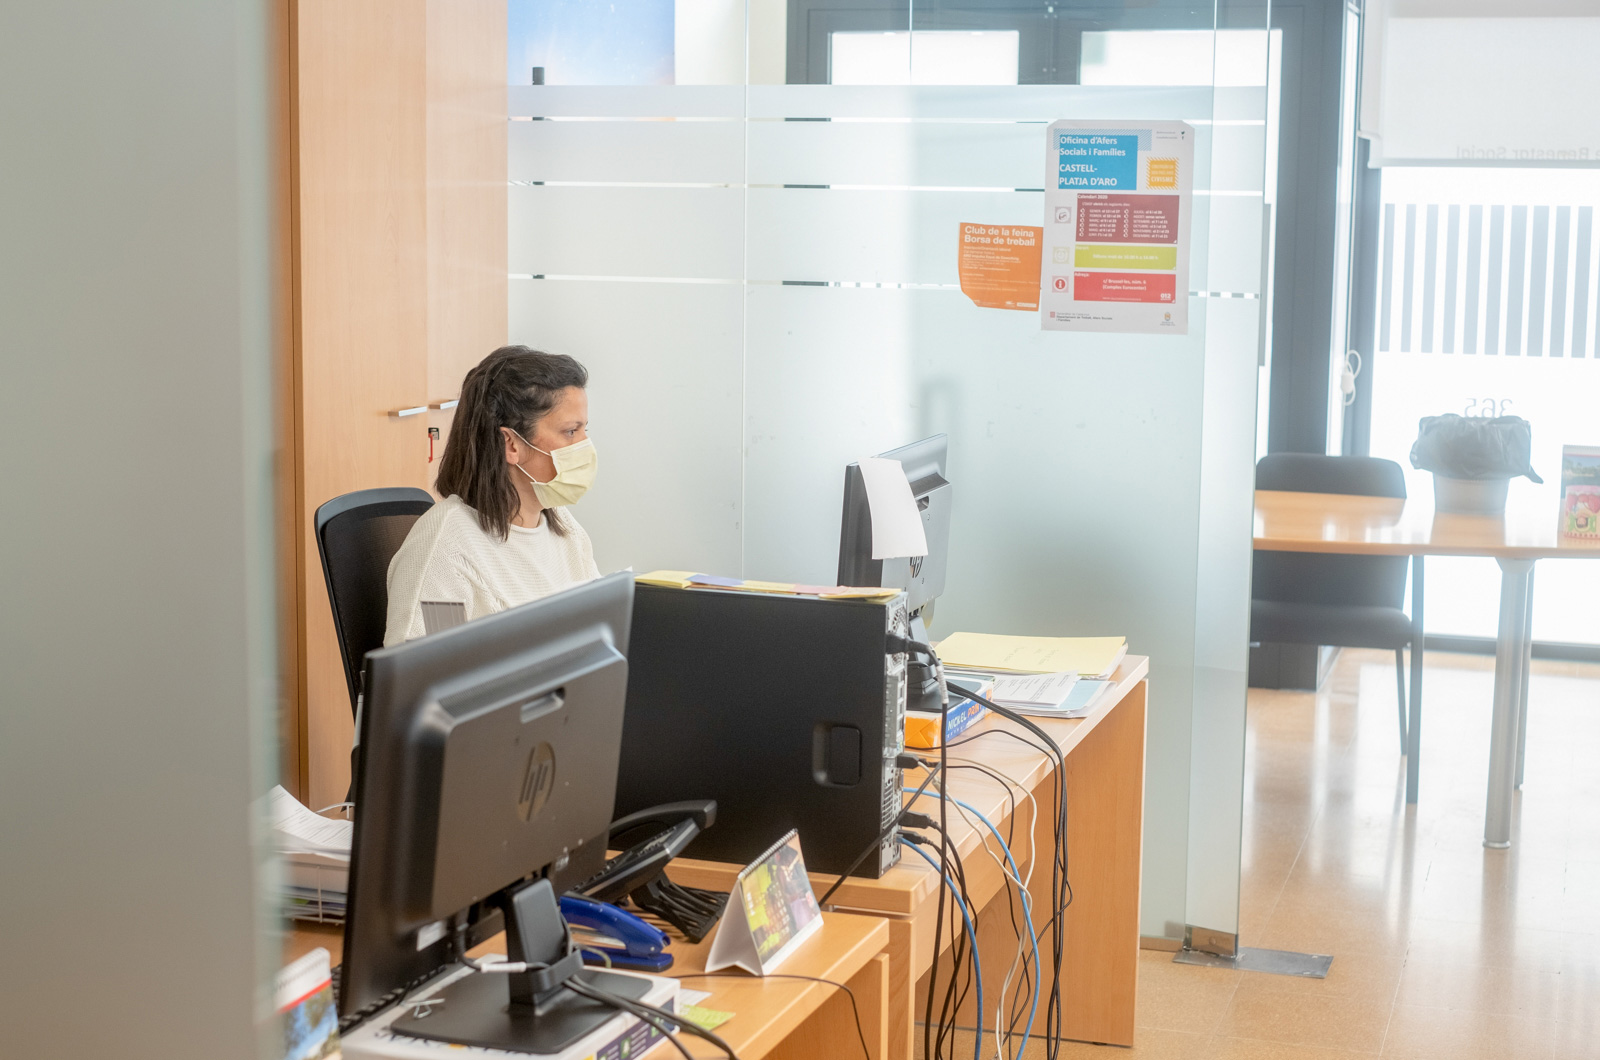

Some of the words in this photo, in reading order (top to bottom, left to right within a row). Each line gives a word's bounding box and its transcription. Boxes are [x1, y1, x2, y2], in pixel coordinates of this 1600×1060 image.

[1060, 136, 1088, 145] Oficina
[1090, 136, 1118, 145] d'Afers
[1060, 148, 1087, 156] Socials
[1094, 148, 1126, 156] Famílies
[1059, 164, 1098, 172] CASTELL-
[1059, 178, 1088, 186] PLATJA
[1090, 178, 1118, 186] D'ARO
[964, 226, 986, 234] Club
[988, 226, 999, 235] de
[1001, 228, 1010, 236] la
[1012, 228, 1034, 237] feina
[964, 234, 990, 244] Borsa
[992, 236, 1004, 244] de
[1006, 237, 1035, 246] treball
